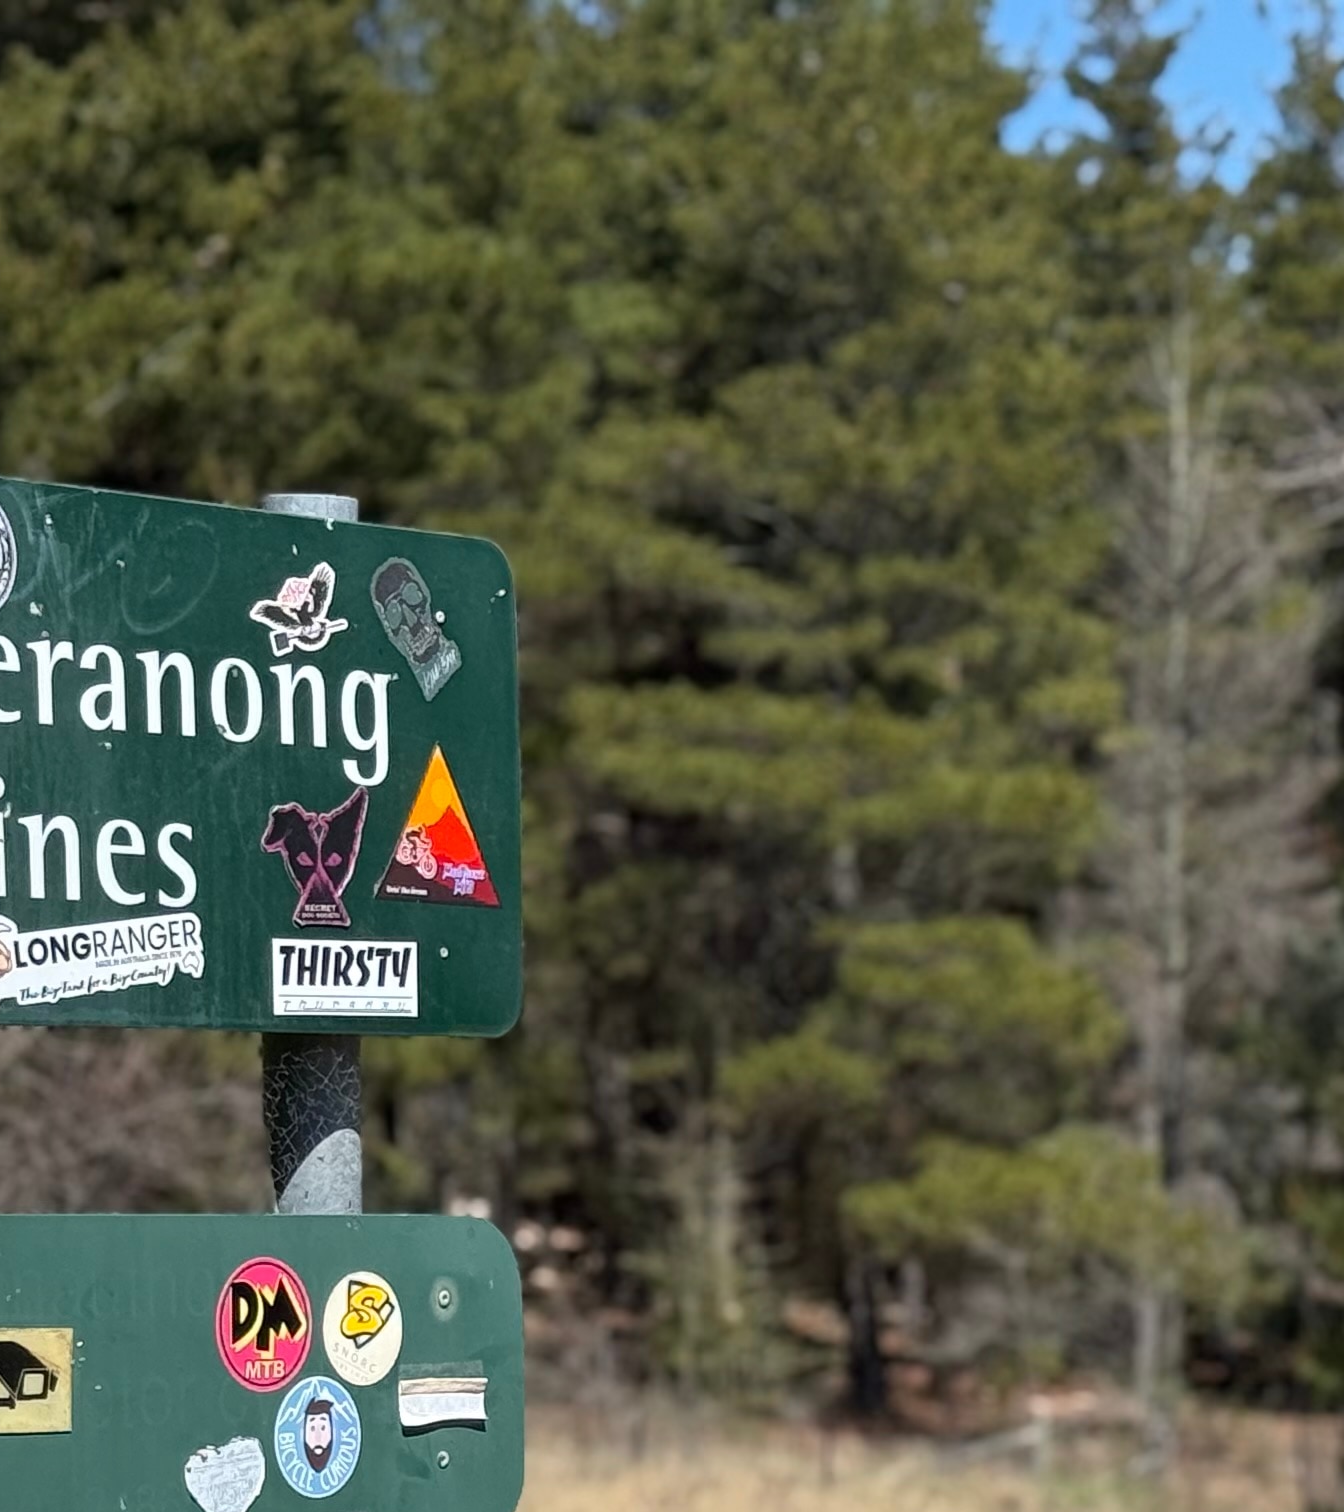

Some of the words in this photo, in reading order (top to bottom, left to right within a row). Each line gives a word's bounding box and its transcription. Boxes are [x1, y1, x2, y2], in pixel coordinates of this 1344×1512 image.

[13, 918, 199, 969] LONGRANGER
[279, 945, 412, 988] THIRSTY
[244, 1359, 286, 1380] MTB
[279, 1432, 314, 1492] BICYCLE
[320, 1426, 357, 1491] CURIOUS
